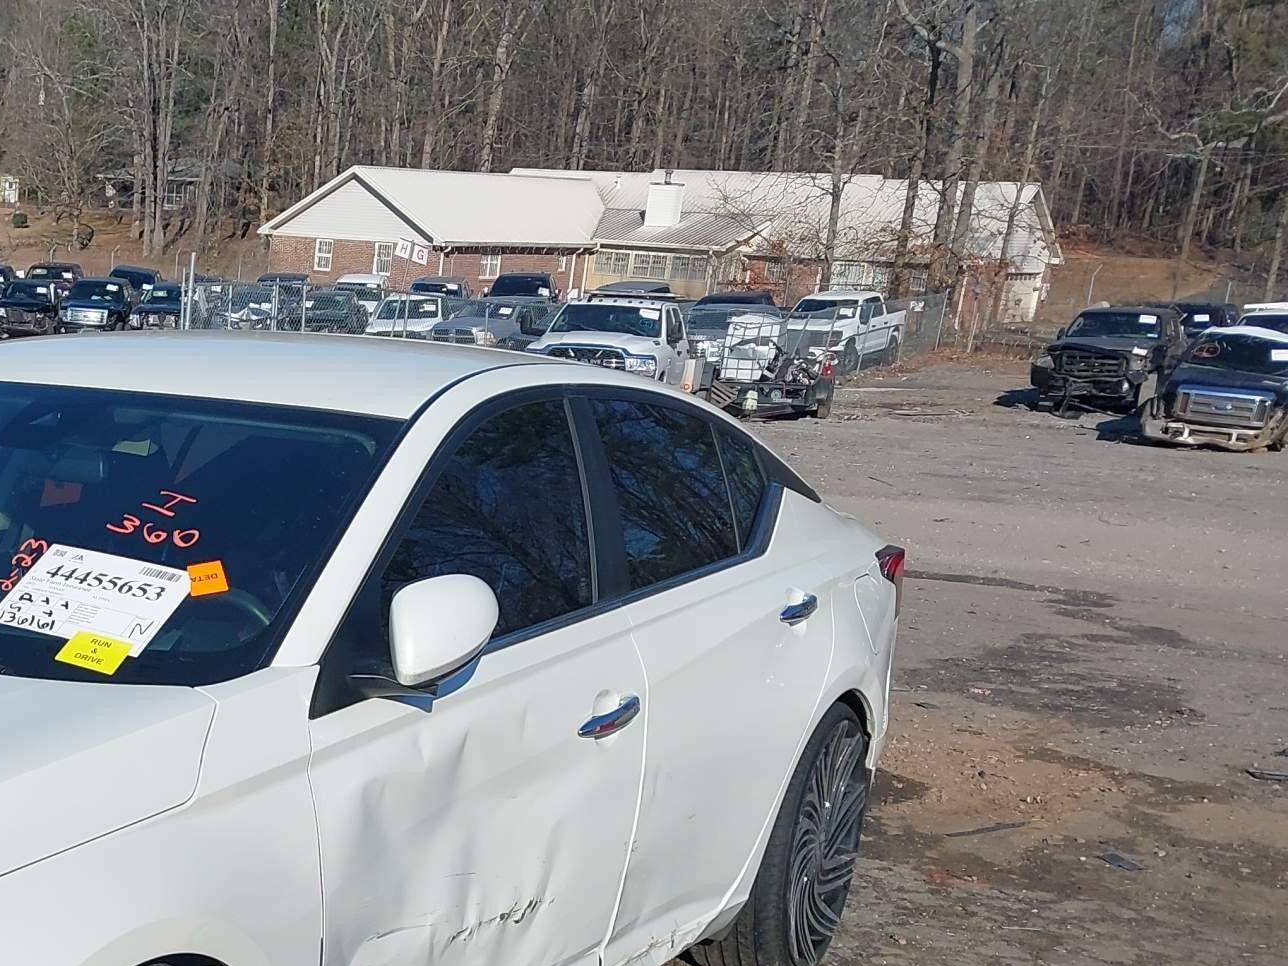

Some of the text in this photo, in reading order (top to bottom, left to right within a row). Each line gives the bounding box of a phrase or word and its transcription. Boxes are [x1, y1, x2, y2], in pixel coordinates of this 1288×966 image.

[400, 242, 409, 255] H
[417, 249, 425, 261] G
[106, 514, 201, 548] 360
[46, 564, 167, 602] 44455653
[90, 638, 112, 649] RUN
[73, 652, 105, 665] DRIVE
